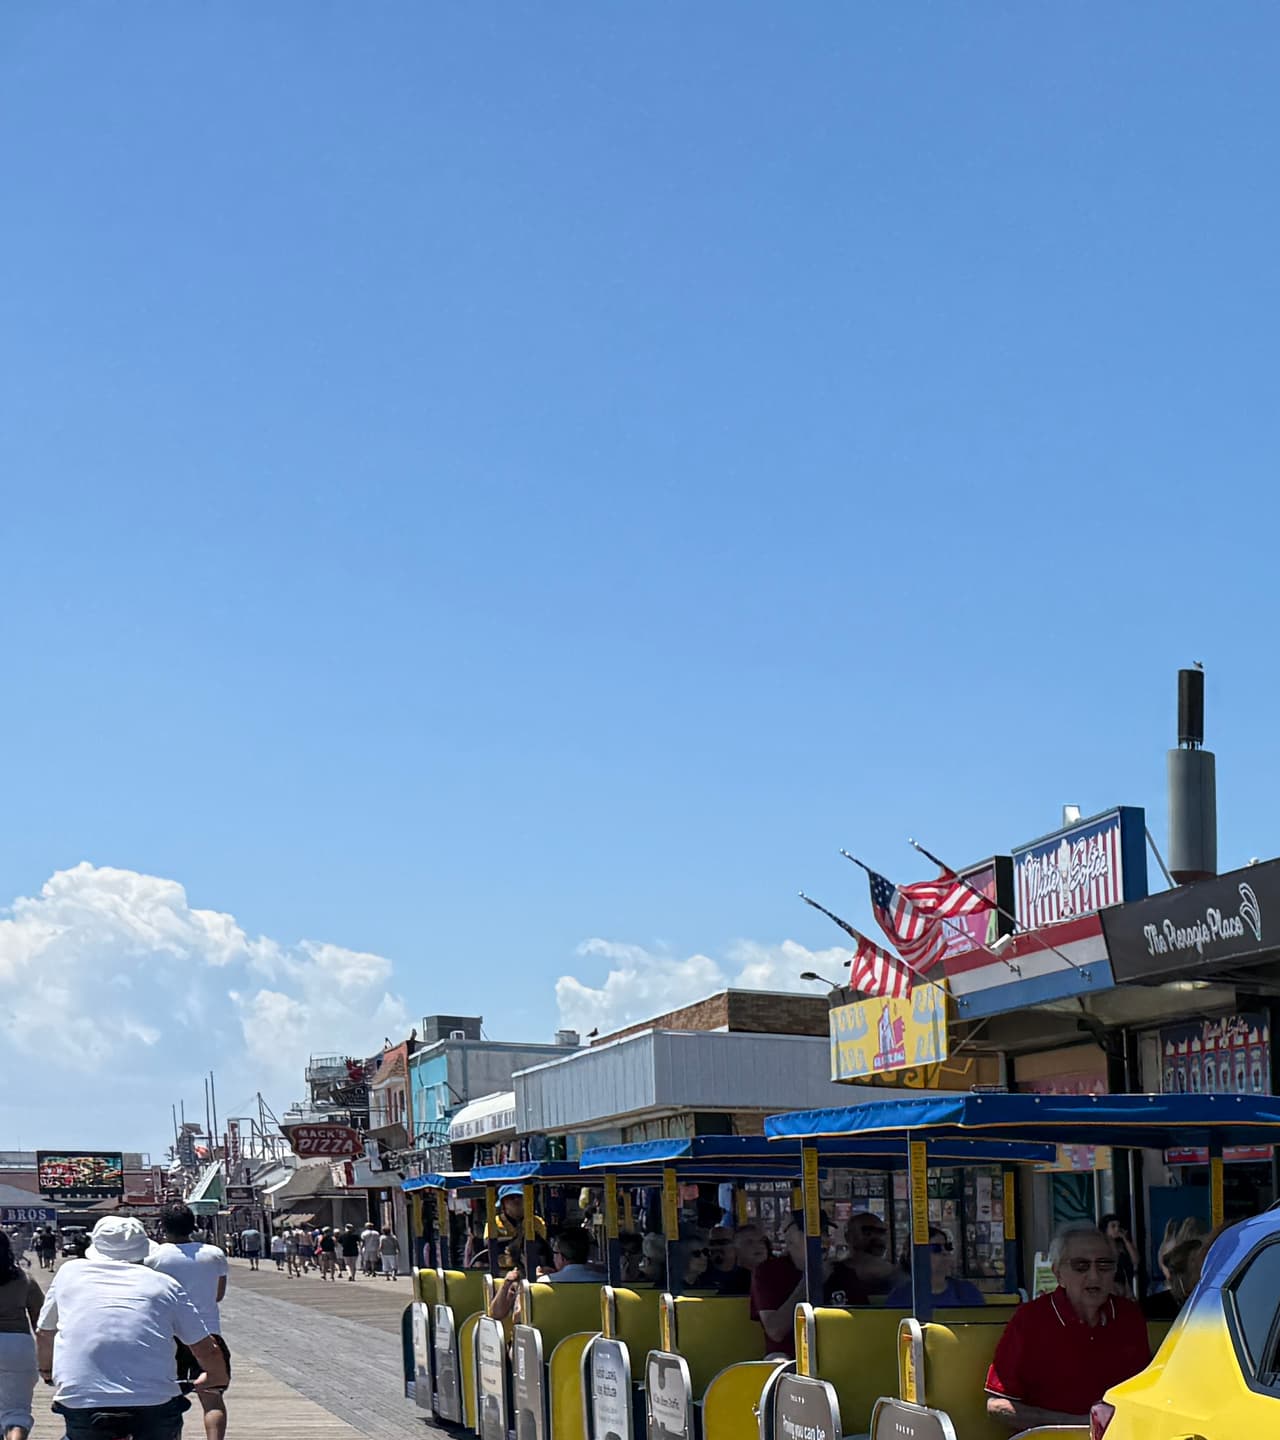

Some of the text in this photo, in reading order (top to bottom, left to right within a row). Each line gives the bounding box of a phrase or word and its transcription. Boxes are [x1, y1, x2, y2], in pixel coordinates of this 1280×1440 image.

[298, 1128, 348, 1139] MACK'S
[298, 1138, 354, 1153] PIZZA
[7, 1208, 48, 1221] BROS
